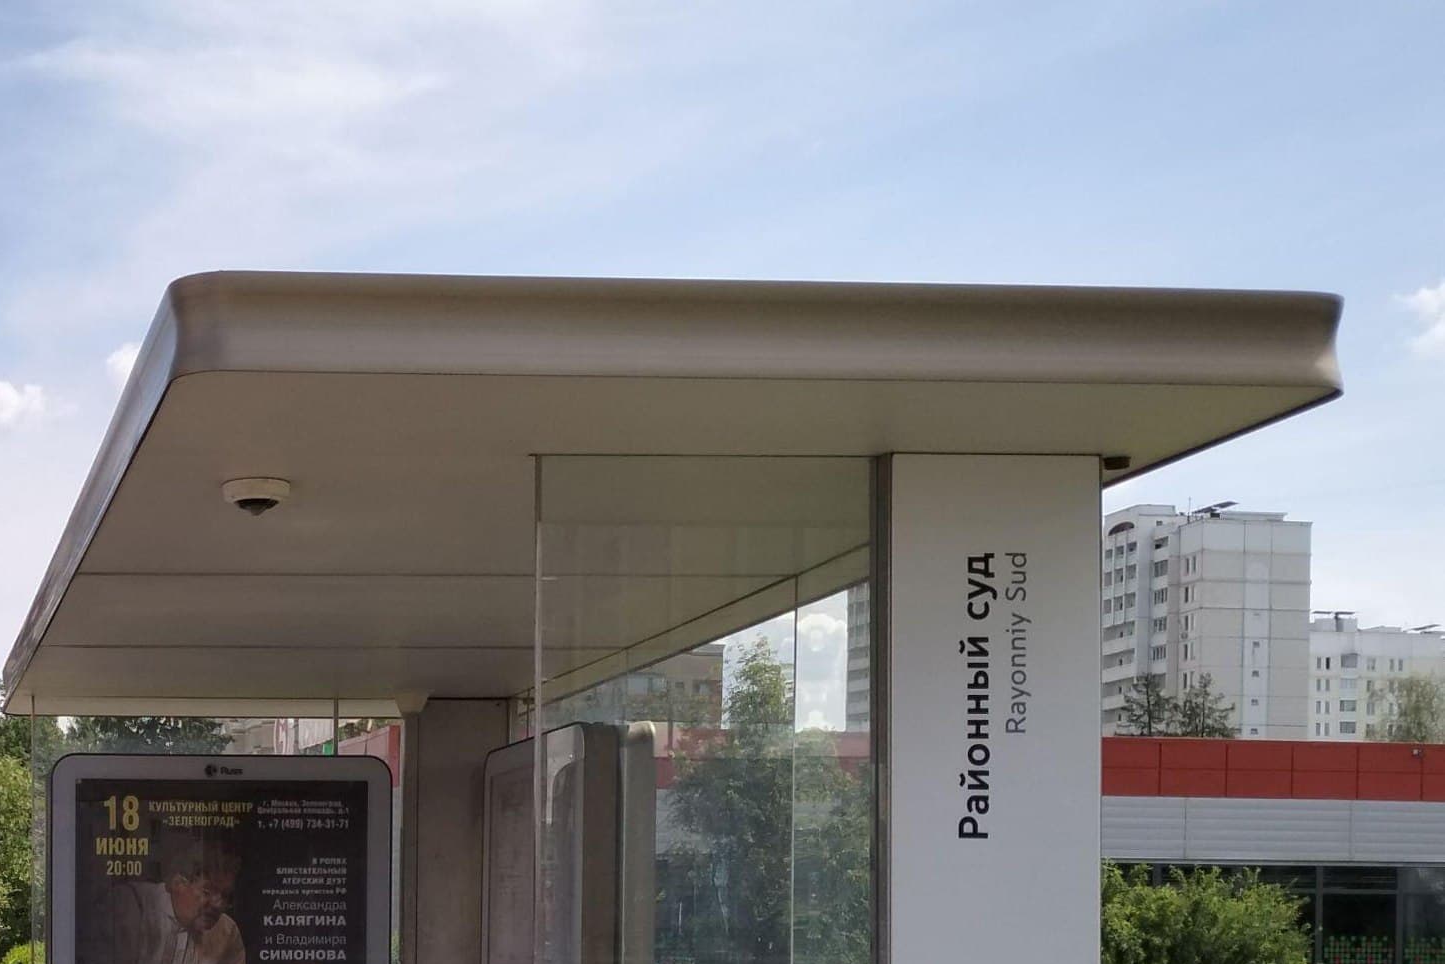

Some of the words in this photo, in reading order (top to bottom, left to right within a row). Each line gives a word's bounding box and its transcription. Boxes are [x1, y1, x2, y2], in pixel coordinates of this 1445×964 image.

[1005, 552, 1026, 601] Sud
[967, 552, 998, 620] суд
[1005, 612, 1032, 734] Rayonniy
[958, 636, 991, 839] Районный
[102, 794, 140, 831] 18
[148, 799, 219, 813] КУЛЬТУРНЫЙ
[221, 802, 253, 814] ЦЕНТР
[95, 837, 149, 856] ИЮНЯ
[106, 860, 143, 877] 20:00
[273, 899, 347, 913] Александра
[263, 915, 347, 926] КАЛЯГИНА
[265, 936, 273, 945] и
[276, 933, 347, 947] Владимира
[259, 949, 347, 961] СИМОНОВА
